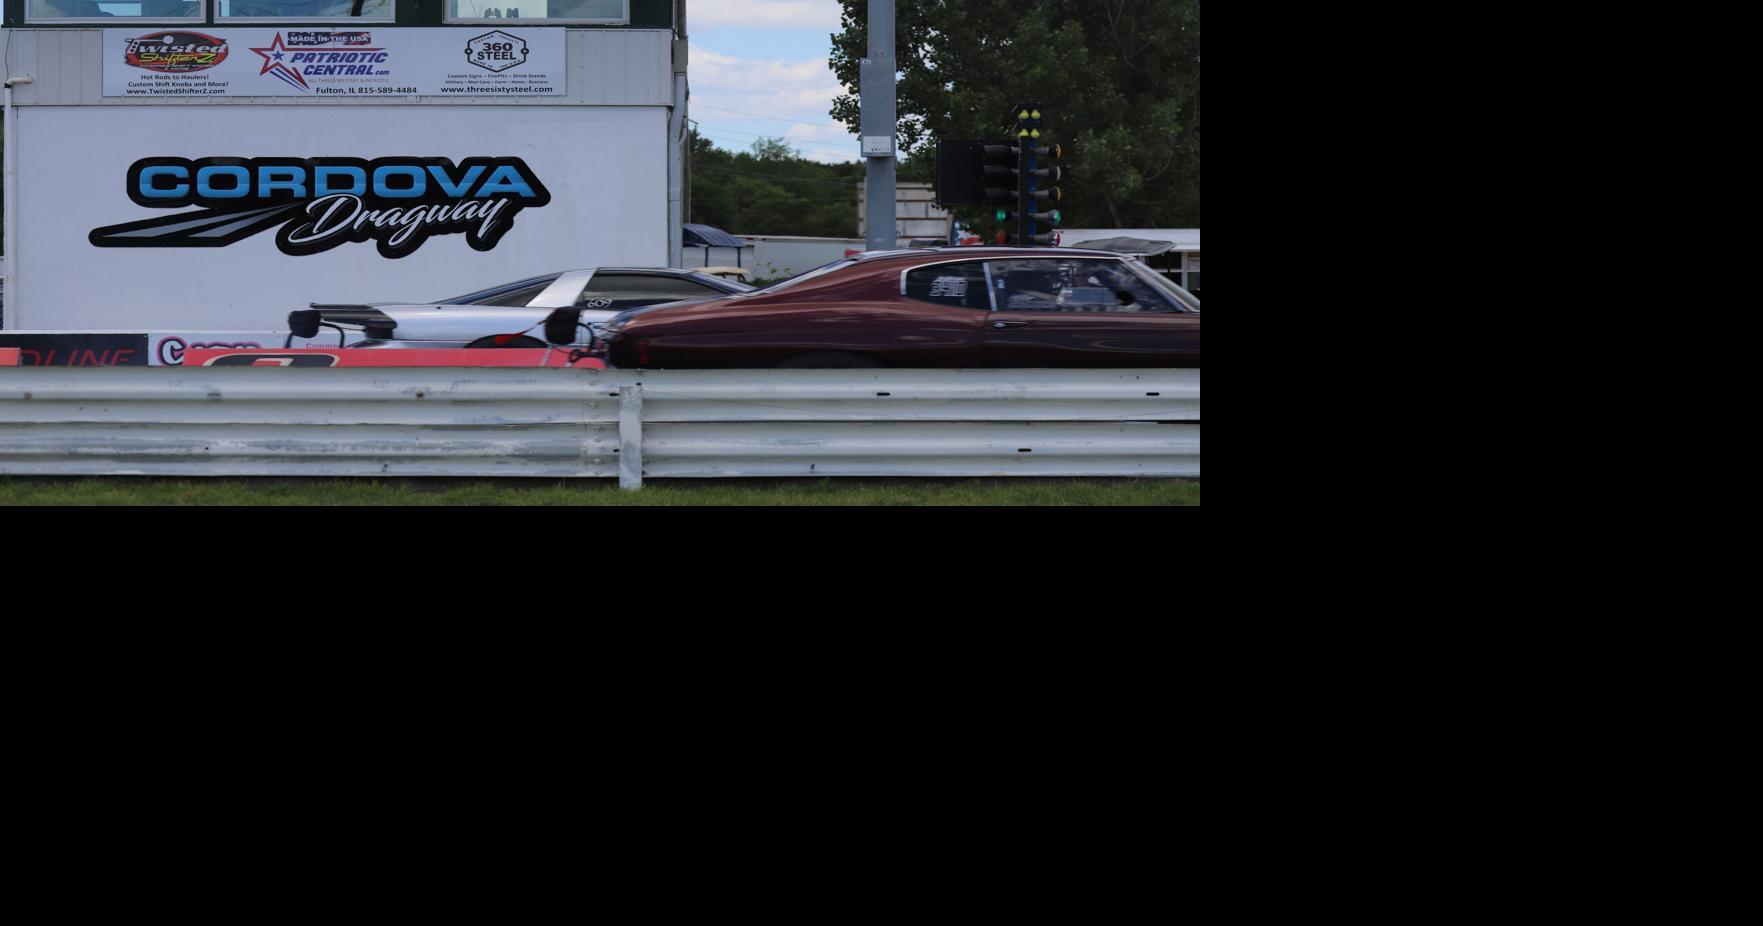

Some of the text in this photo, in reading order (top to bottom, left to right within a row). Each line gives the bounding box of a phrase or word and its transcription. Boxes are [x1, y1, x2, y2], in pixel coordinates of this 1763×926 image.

[126, 39, 228, 54] Twisted
[482, 42, 513, 52] 360
[290, 52, 389, 63] PATRIOTIC
[477, 51, 517, 61] STEEL
[315, 87, 346, 95] Fulton,
[138, 165, 537, 199] CORDOVA
[288, 193, 508, 247] Dragway
